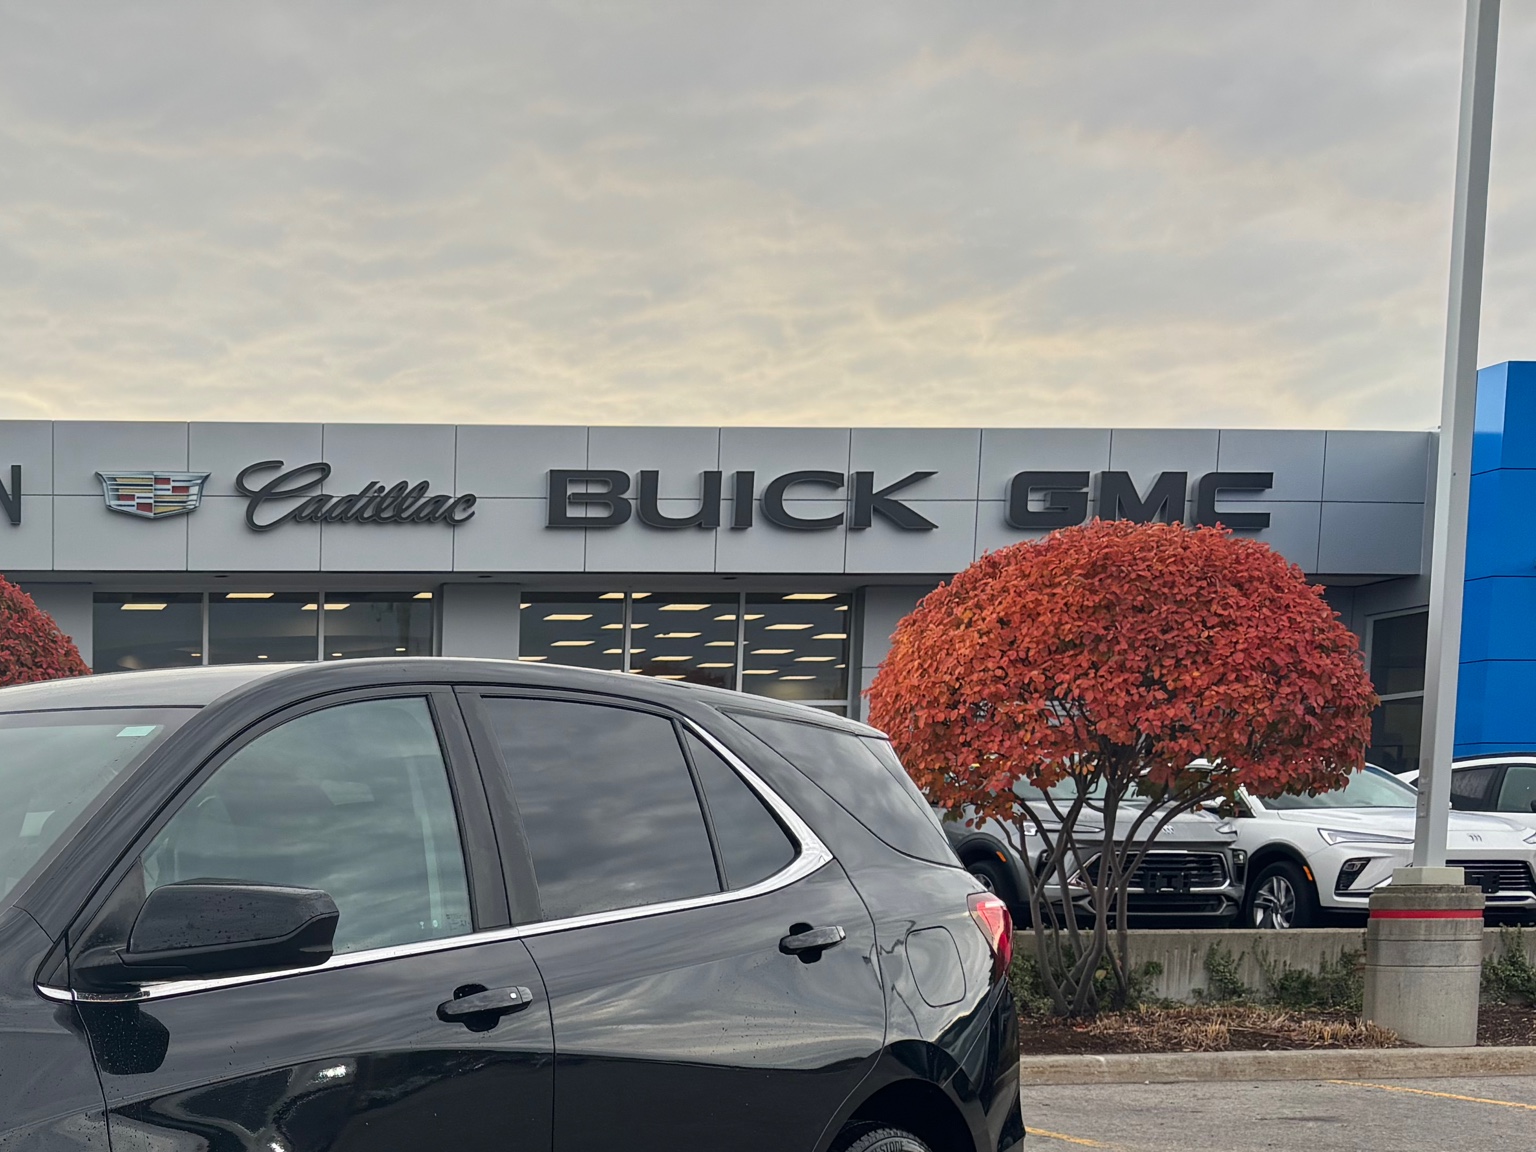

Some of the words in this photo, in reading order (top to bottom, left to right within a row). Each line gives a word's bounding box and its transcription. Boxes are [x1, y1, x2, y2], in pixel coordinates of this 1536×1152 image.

[234, 460, 477, 531] Cadillac
[545, 469, 940, 530] BUICK
[1005, 471, 1275, 529] GMC
